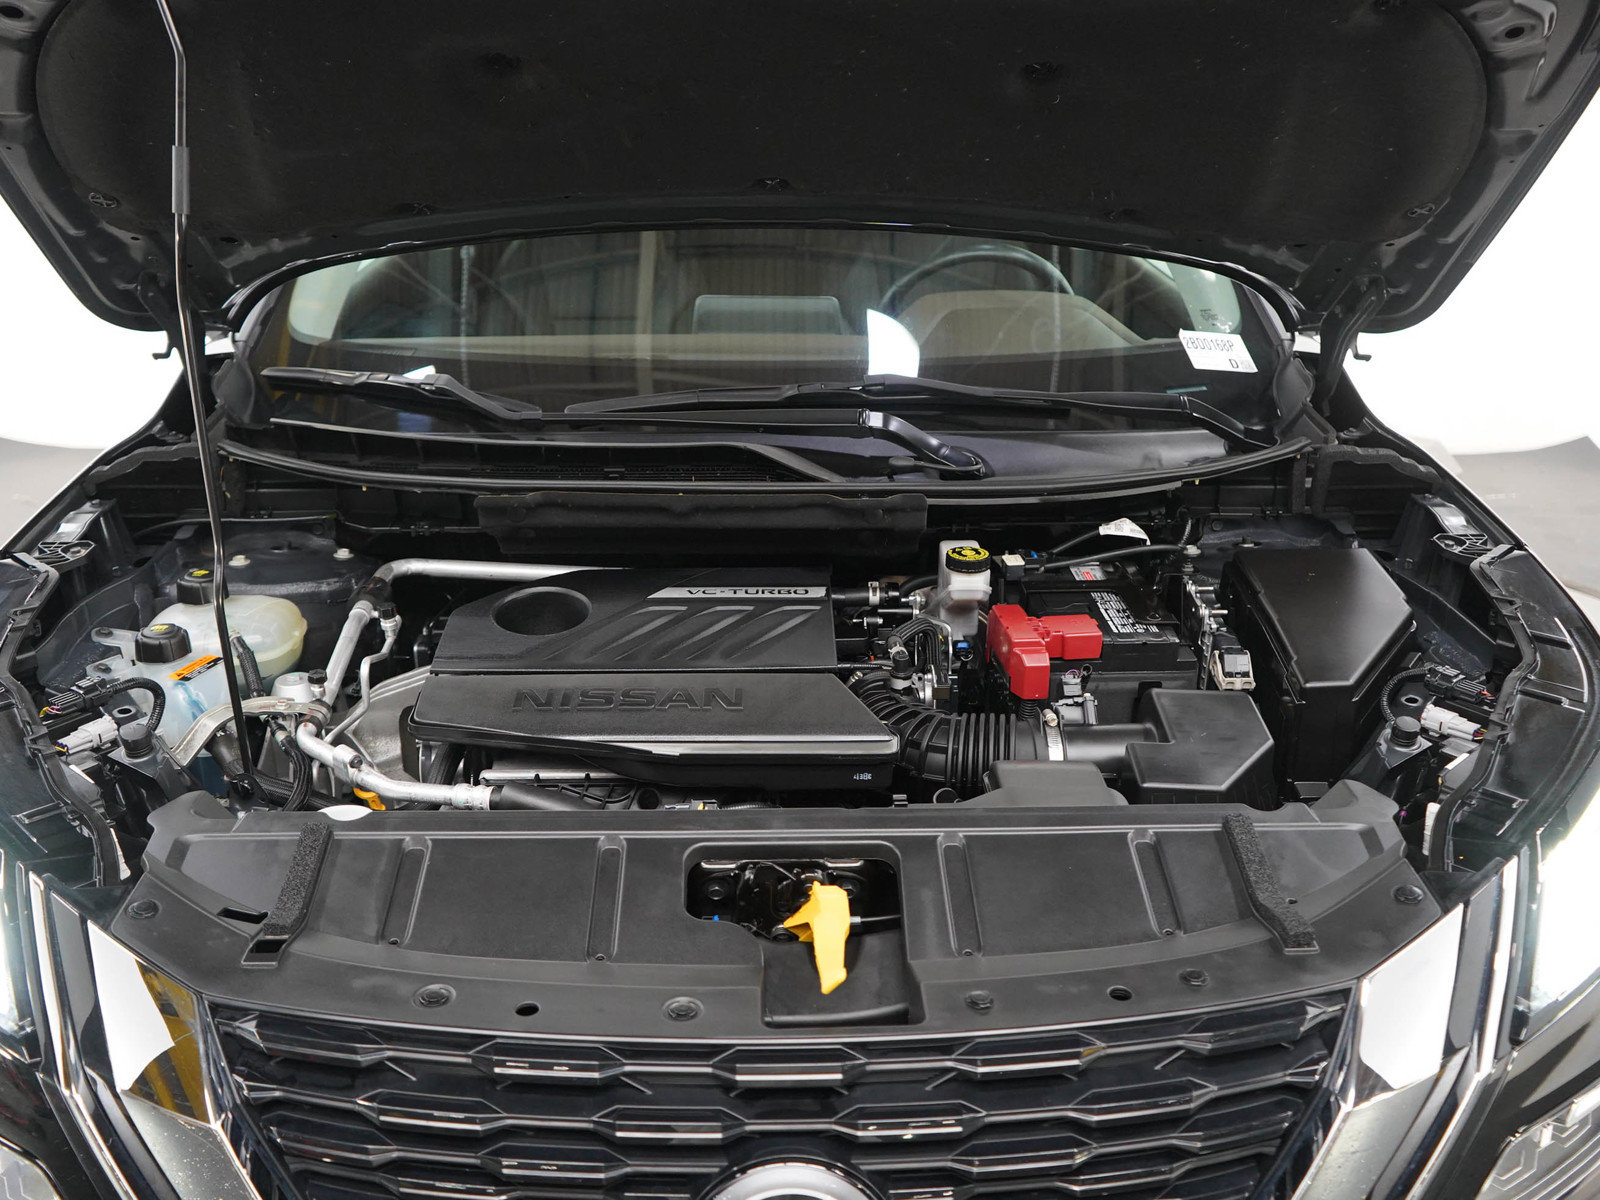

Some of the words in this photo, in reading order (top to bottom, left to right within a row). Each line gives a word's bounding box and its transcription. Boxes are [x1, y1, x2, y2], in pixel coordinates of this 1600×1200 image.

[1228, 358, 1239, 369] D
[686, 588, 809, 596] VC-TURBO
[512, 687, 744, 711] NISSAN
